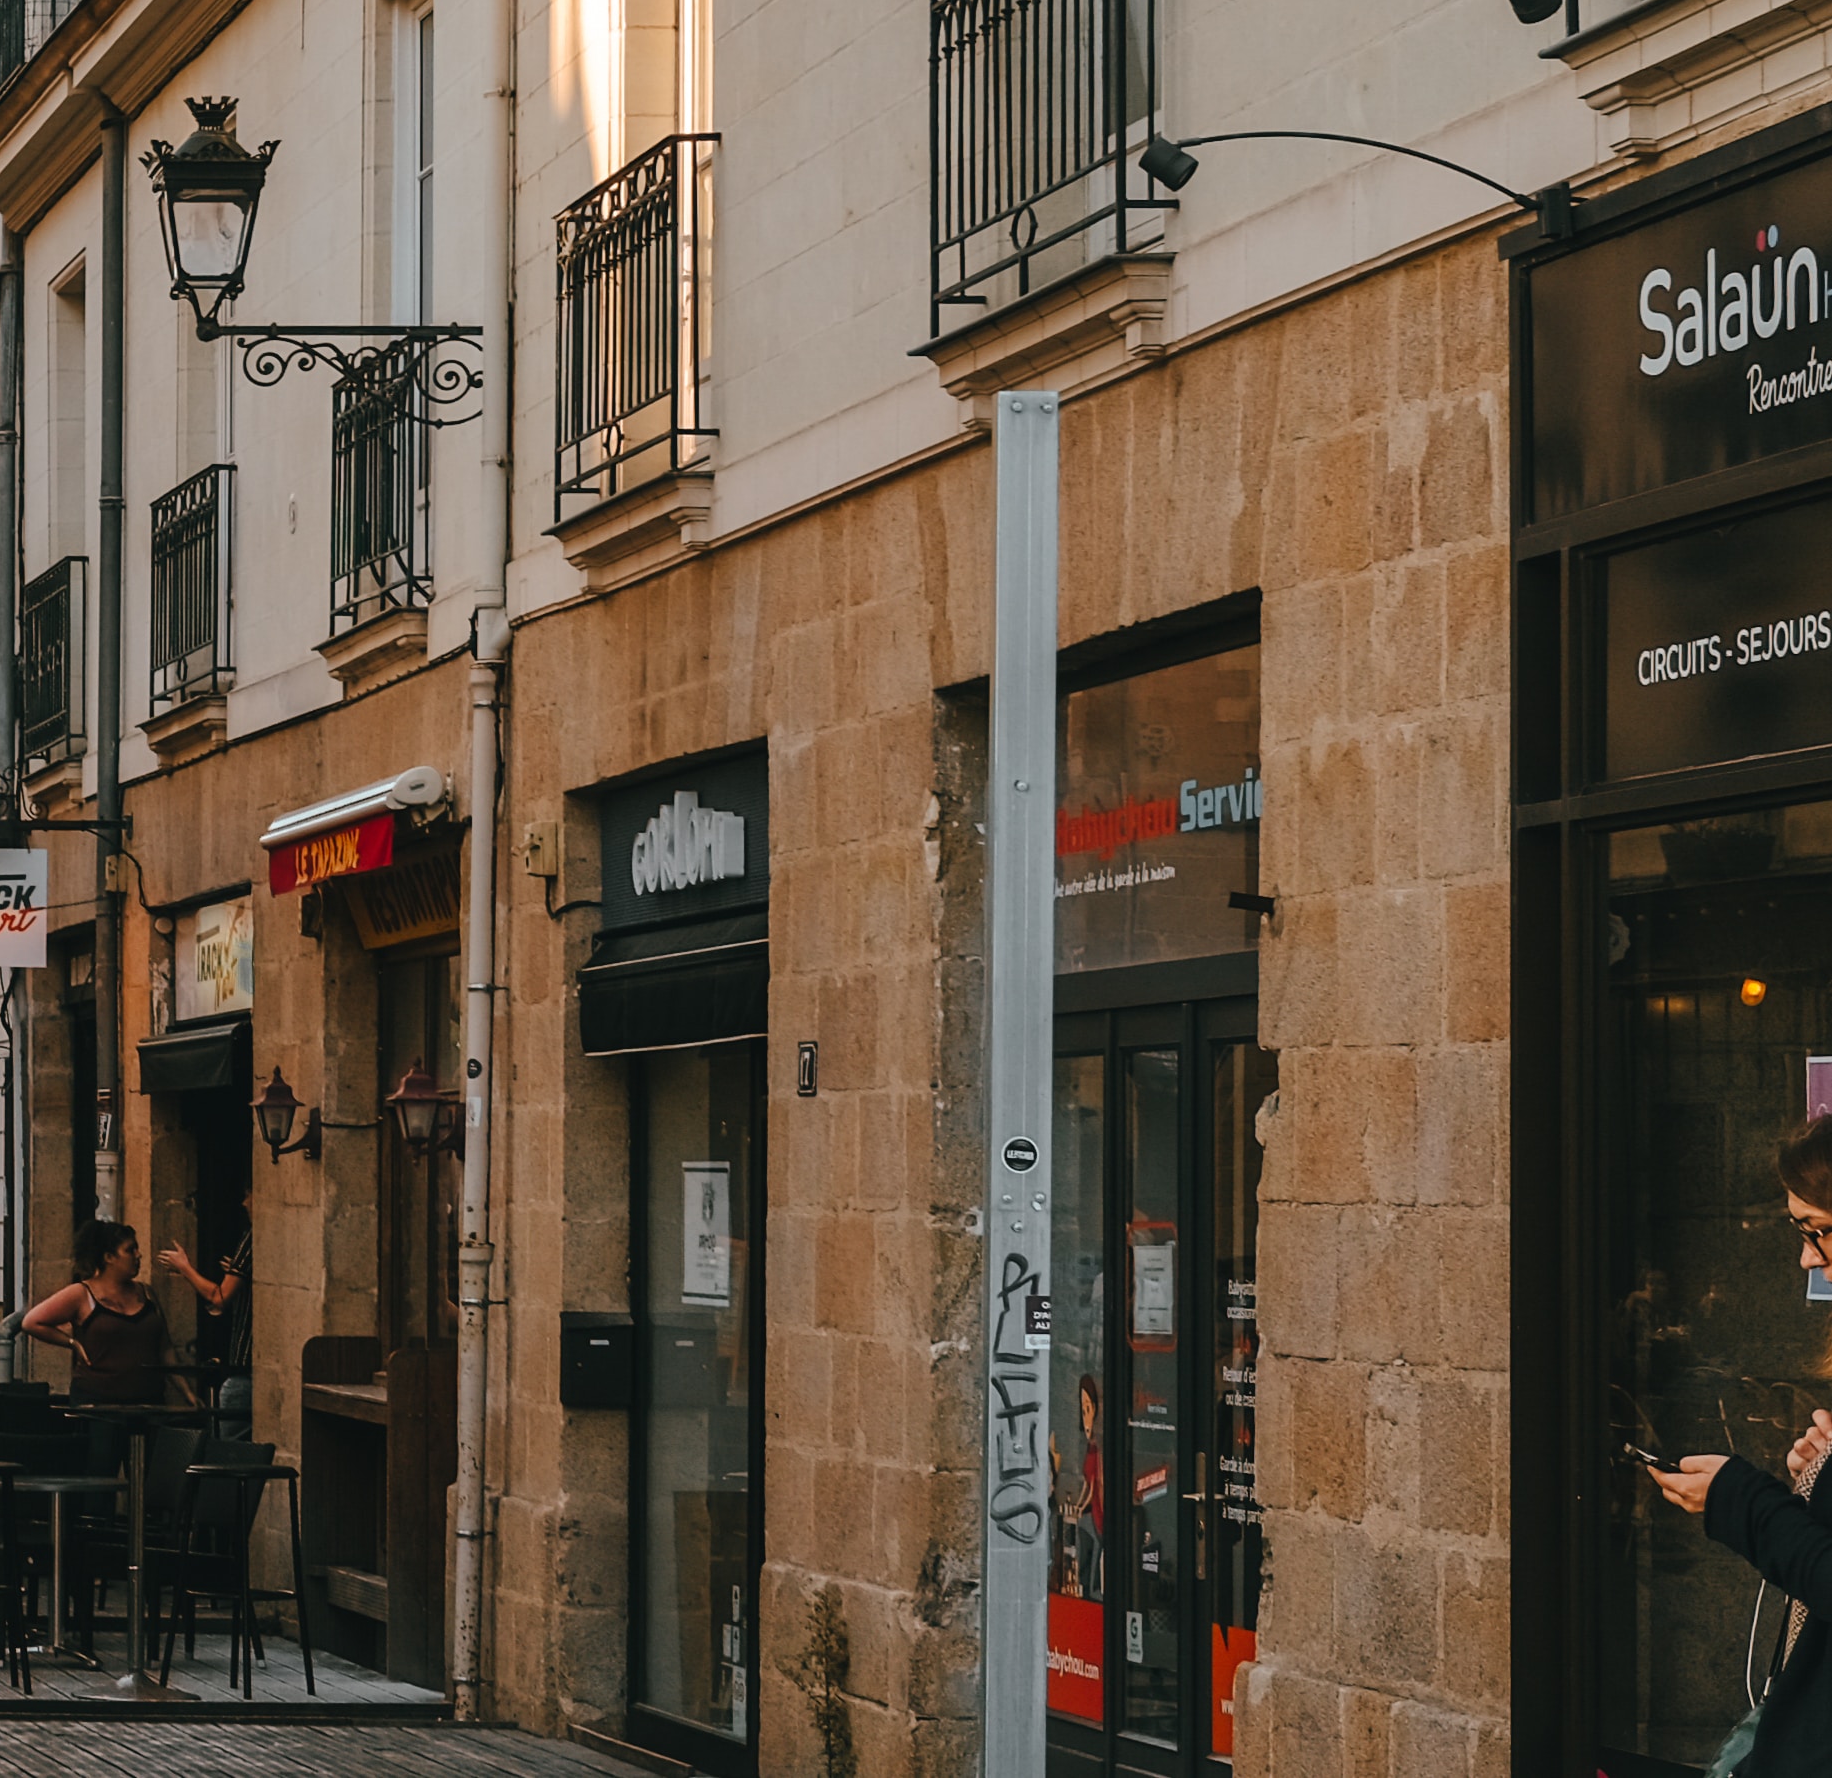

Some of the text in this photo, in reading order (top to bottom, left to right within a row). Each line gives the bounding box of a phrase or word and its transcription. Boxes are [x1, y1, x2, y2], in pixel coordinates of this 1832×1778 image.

[1639, 225, 1819, 376] Salaün
[1638, 635, 1722, 686] CIRCUITS
[1736, 610, 1832, 665] SEJOURS
[295, 846, 308, 886] LE
